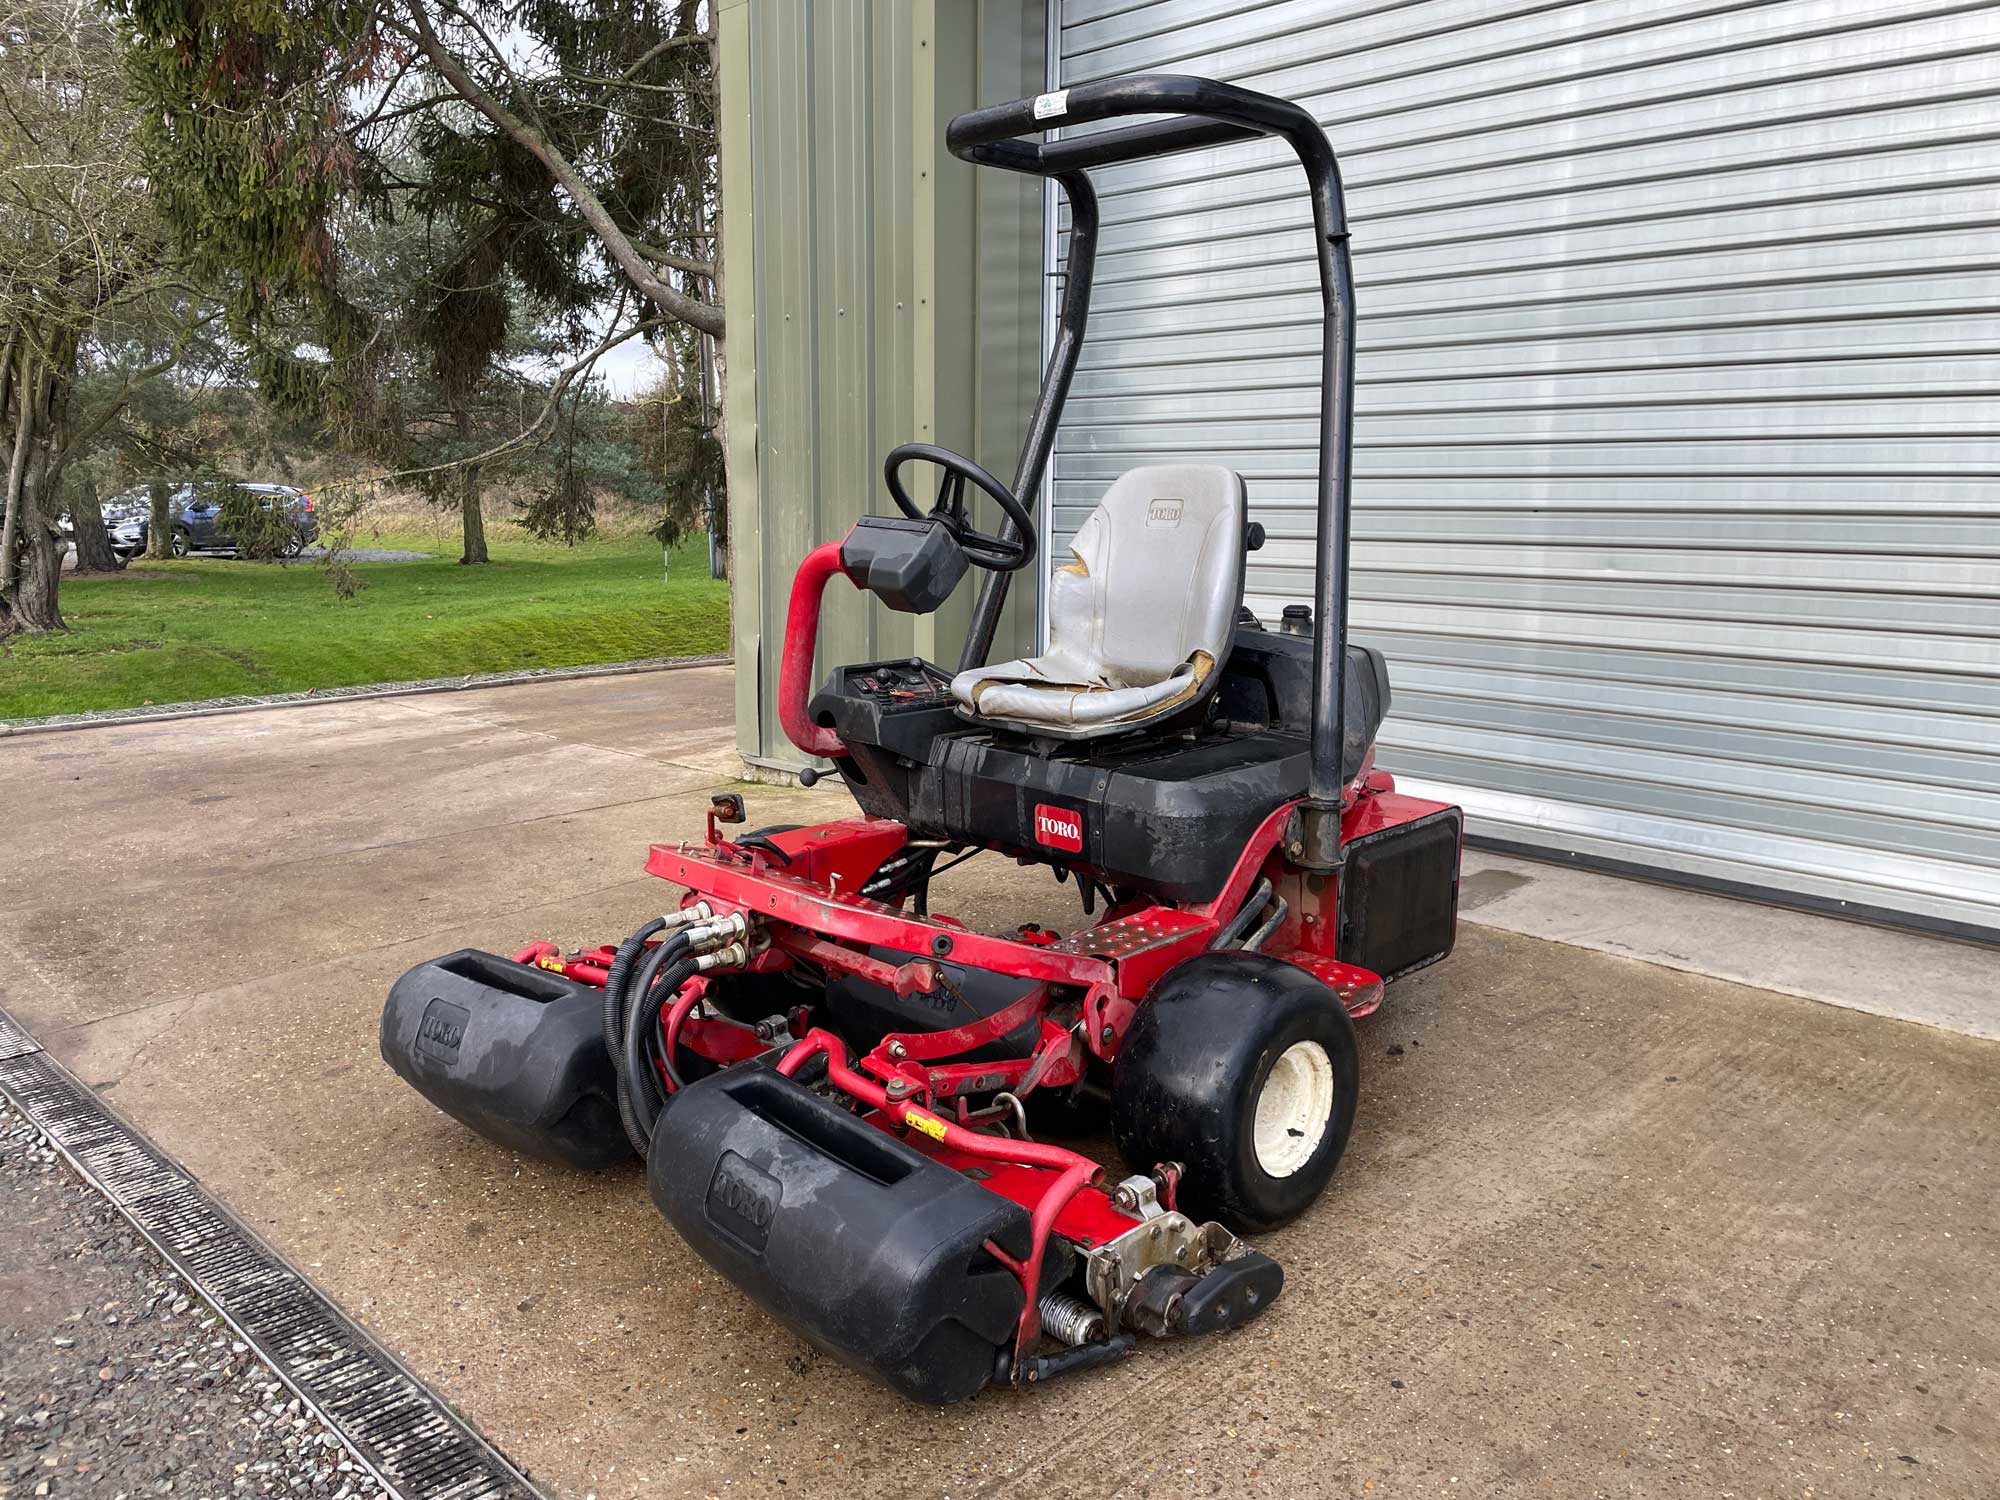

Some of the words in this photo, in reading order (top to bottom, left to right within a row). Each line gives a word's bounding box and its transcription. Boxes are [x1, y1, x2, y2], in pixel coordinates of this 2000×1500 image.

[1151, 508, 1181, 520] TORO
[1039, 816, 1078, 839] TORO
[423, 1016, 460, 1048] TORO
[714, 1172, 771, 1227] TORO
